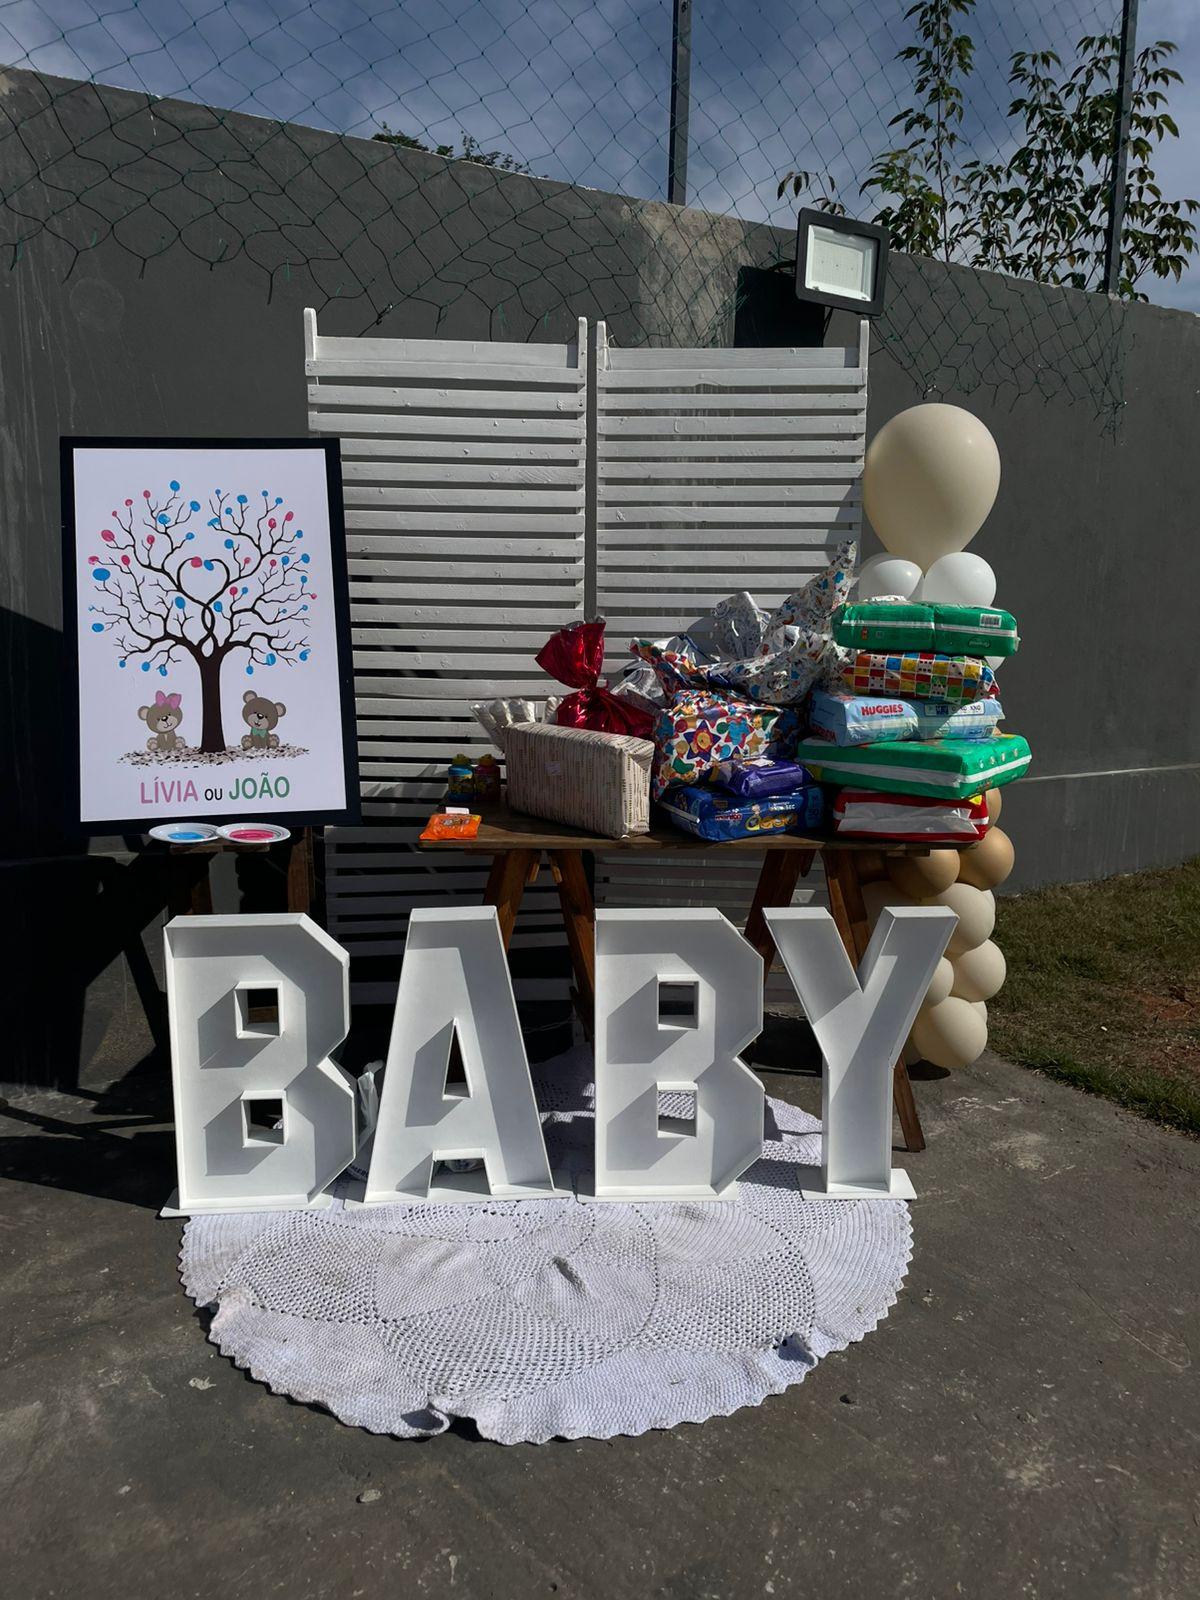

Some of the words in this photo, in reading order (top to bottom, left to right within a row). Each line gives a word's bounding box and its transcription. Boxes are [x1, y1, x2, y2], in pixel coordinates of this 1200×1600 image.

[861, 704, 903, 716] HUGGIES
[140, 776, 199, 804] LÍVIA
[229, 772, 290, 800] JOÃO
[162, 906, 959, 1215] BABY
